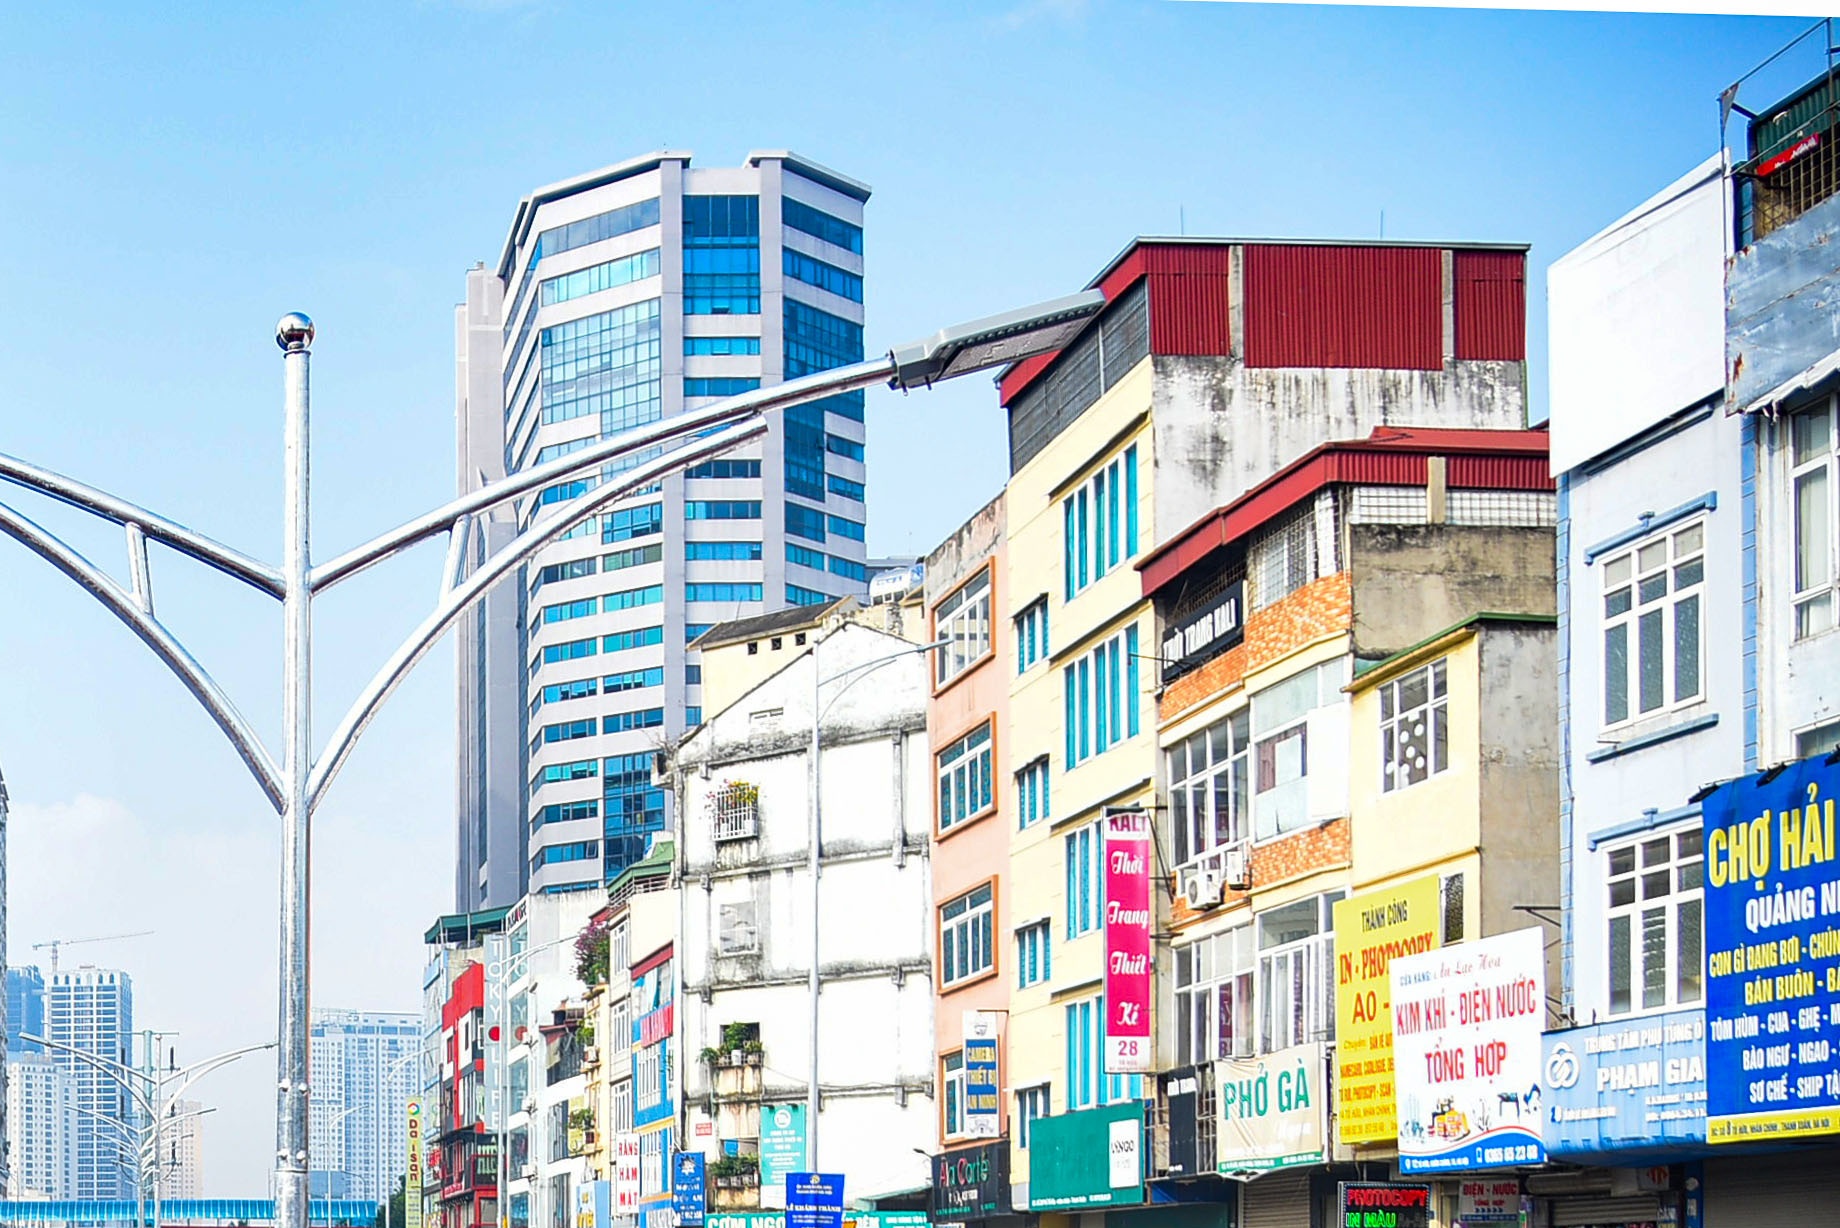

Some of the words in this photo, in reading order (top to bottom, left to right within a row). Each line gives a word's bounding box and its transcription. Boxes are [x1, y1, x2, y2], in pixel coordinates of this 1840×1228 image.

[1185, 612, 1213, 656] TRANG
[1708, 808, 1771, 892] CHỢ
[1779, 782, 1835, 872] HẢI
[1110, 851, 1144, 875] Thời
[1107, 900, 1149, 929] Trang
[1361, 903, 1386, 933] THÀNH
[1386, 897, 1408, 926] CÔNG
[1745, 882, 1816, 934] QUẢNG
[1110, 951, 1147, 976] Thiết
[1339, 951, 1353, 985] IN
[1709, 951, 1732, 978] CON
[1733, 943, 1745, 974] GÌ
[1747, 941, 1778, 970] ĐANG
[1779, 935, 1800, 965] BƠI
[1395, 1000, 1421, 1036] KIM
[1459, 981, 1492, 1031] ĐIỆN
[1496, 972, 1536, 1018] NƯỚC
[1744, 975, 1773, 1005] BÁN
[1776, 968, 1815, 1000] BUÔN
[1710, 1015, 1733, 1042] TÔM
[1734, 1012, 1759, 1039] HÙM
[1767, 1010, 1790, 1034] CUA
[1798, 1005, 1820, 1033] GHẸ
[1118, 1040, 1138, 1056] 28
[1424, 1037, 1465, 1084] TỔNG
[1474, 1038, 1507, 1084] HỢP
[1743, 1044, 1765, 1071] BÀO
[1766, 1042, 1790, 1067] NGƯ
[1798, 1039, 1830, 1065] NGAO
[1223, 1062, 1269, 1120] PHỞ
[1278, 1057, 1310, 1113] GÀ
[1597, 1060, 1659, 1096] PHẠM
[1664, 1055, 1705, 1086] GIA
[1749, 1079, 1765, 1103] SƠ
[1766, 1072, 1789, 1102] CHẾ
[1797, 1074, 1824, 1099] SHIP
[1346, 1188, 1429, 1207] PHOTOCOPY
[1346, 1211, 1362, 1227] IN
